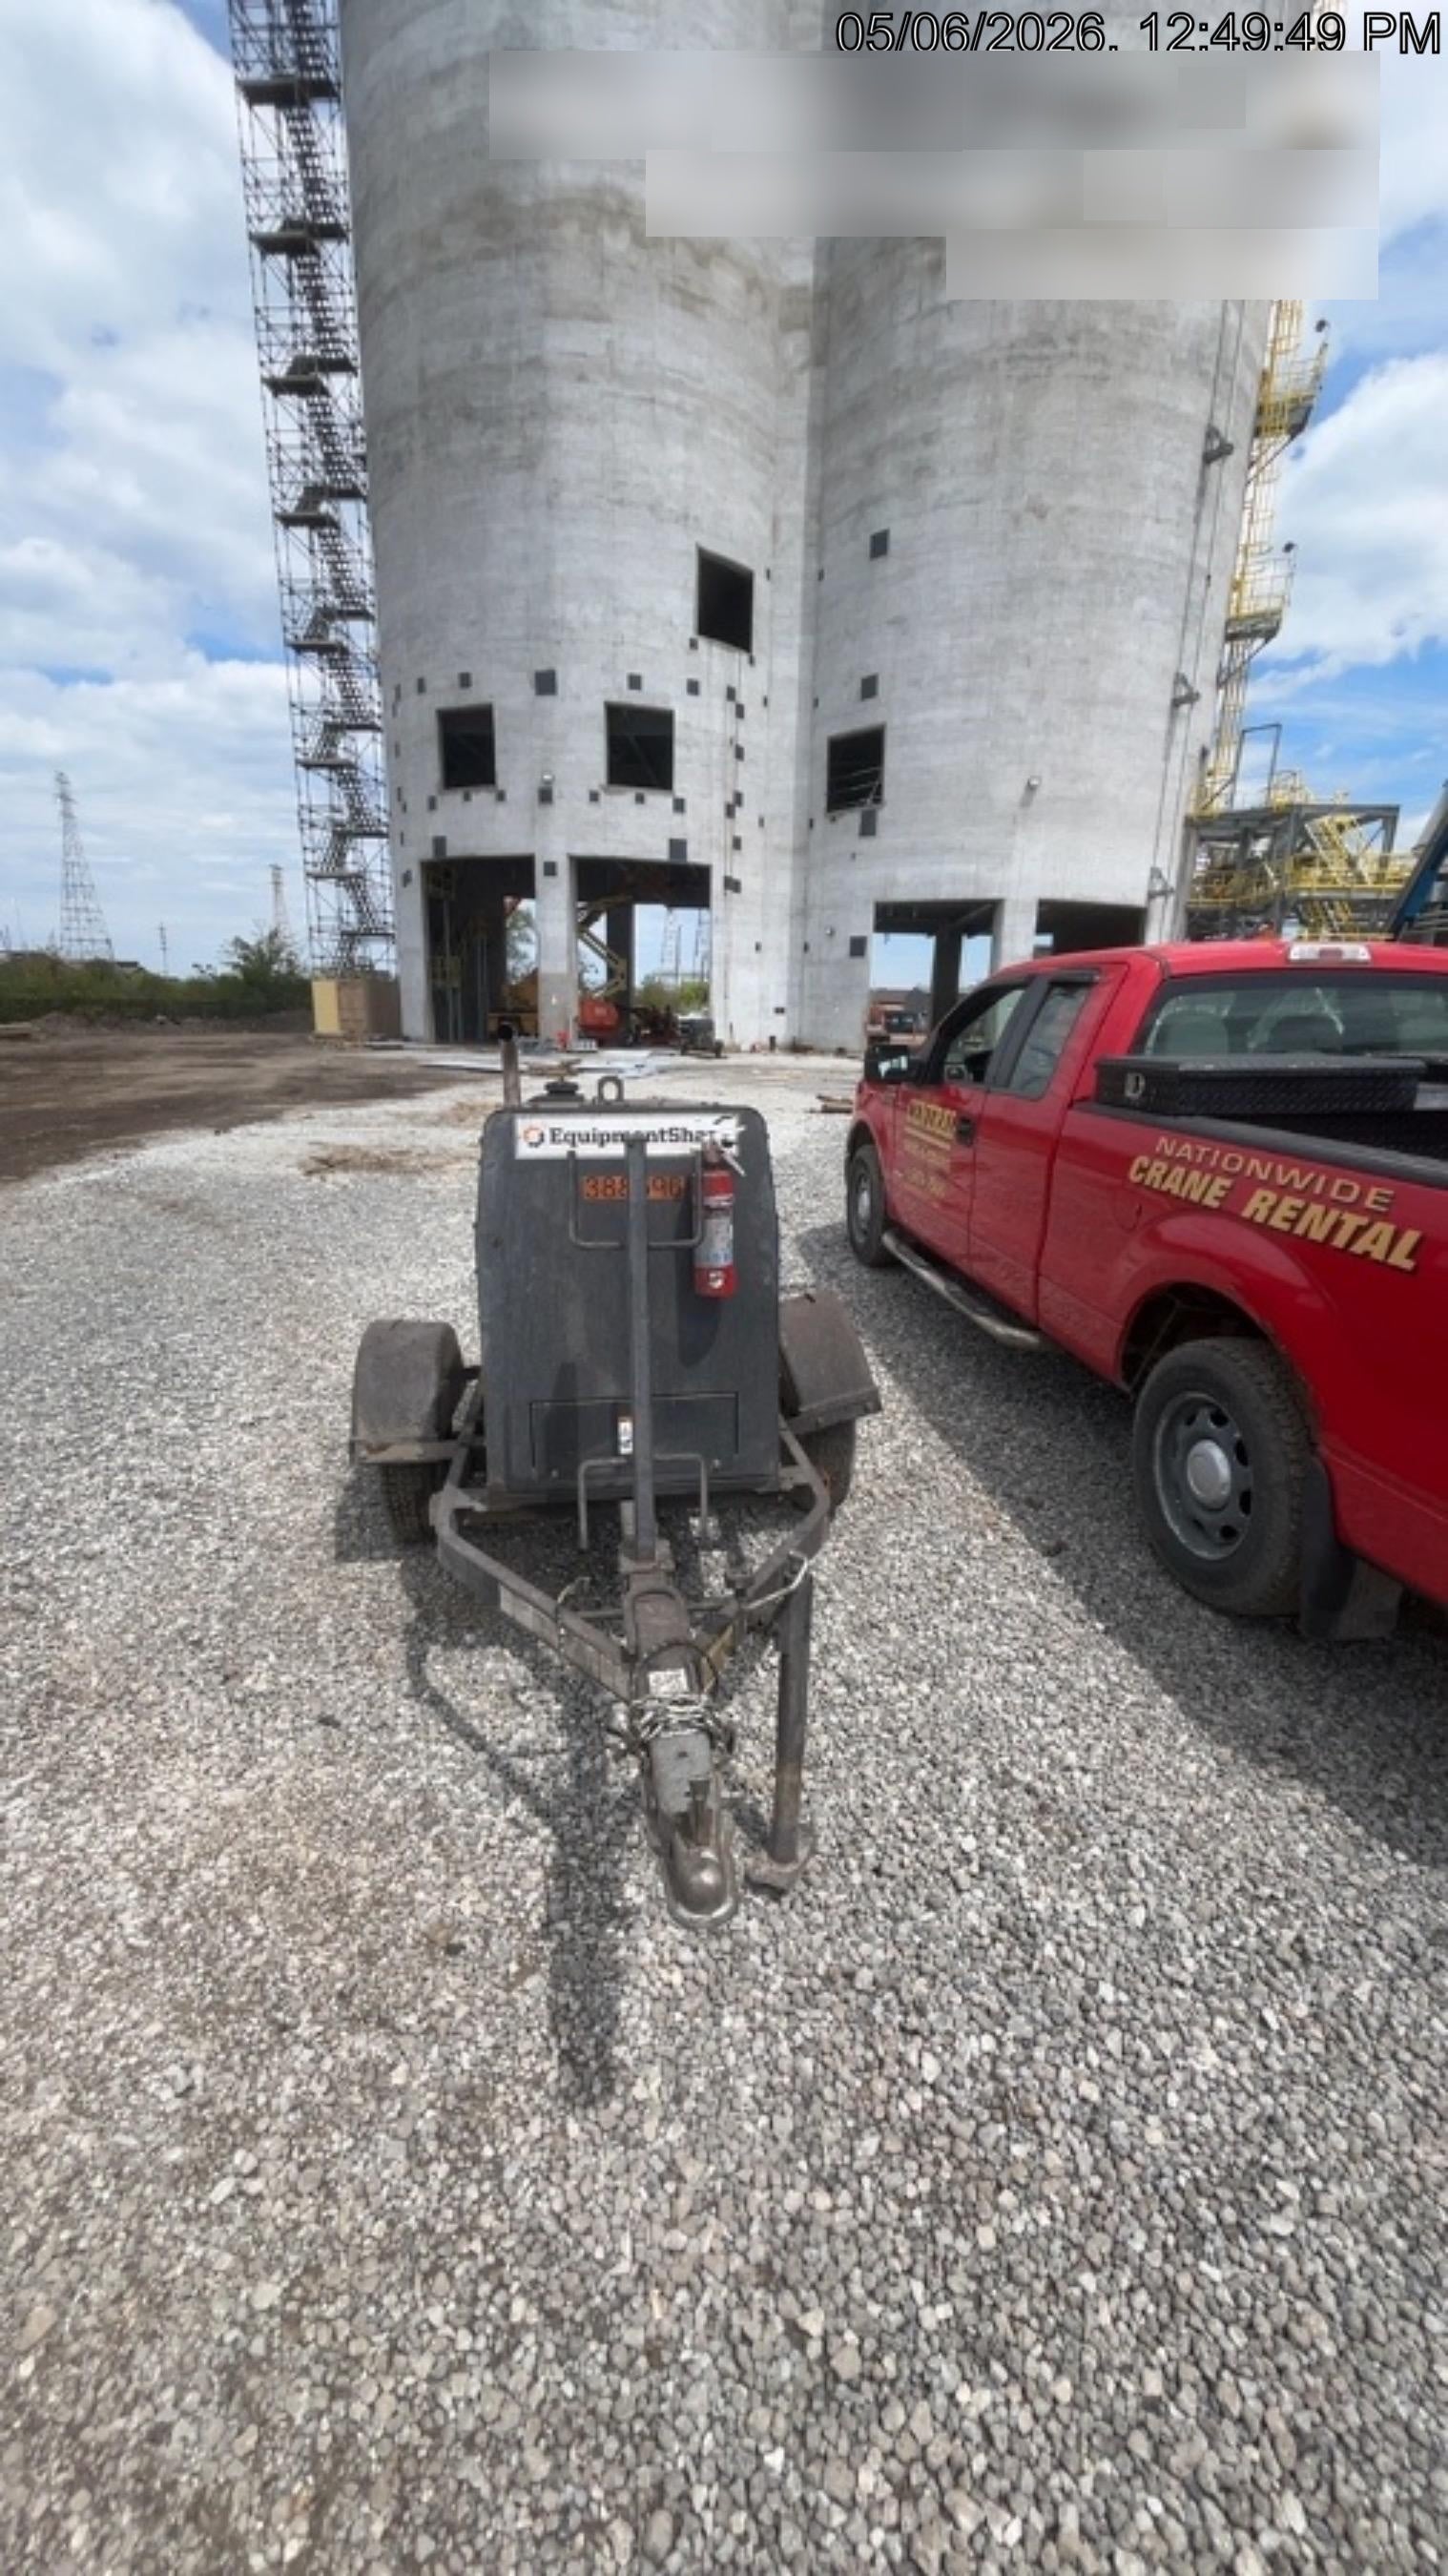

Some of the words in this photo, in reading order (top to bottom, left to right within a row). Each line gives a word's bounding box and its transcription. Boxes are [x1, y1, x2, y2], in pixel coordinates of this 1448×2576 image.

[548, 1127, 723, 1150] EquipmentShar
[586, 1175, 682, 1198] 38890
[1155, 1136, 1396, 1212] NATIONWIDE
[1127, 1155, 1232, 1210] CRANE
[1241, 1189, 1423, 1272] RENTAL
